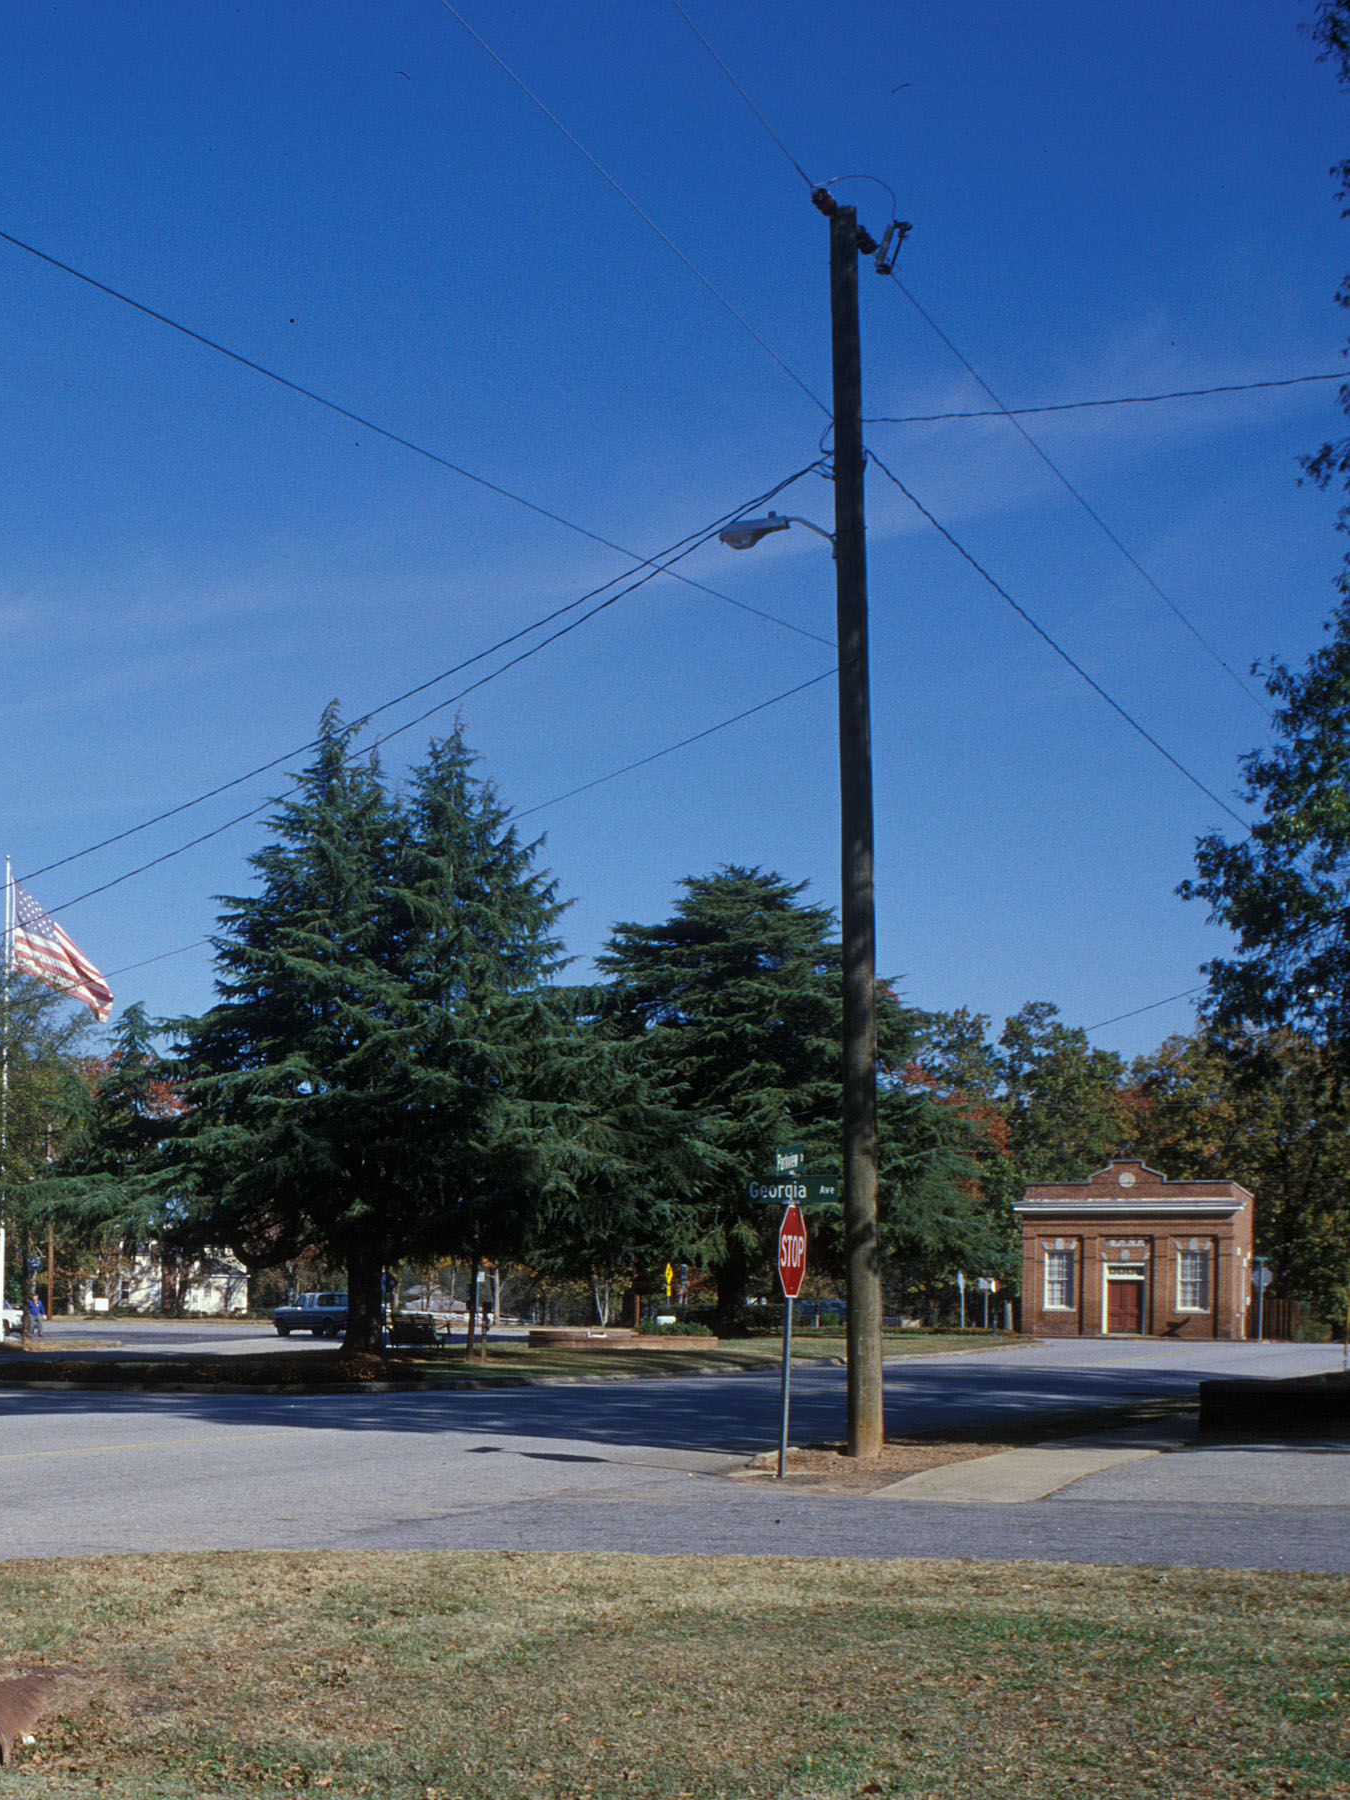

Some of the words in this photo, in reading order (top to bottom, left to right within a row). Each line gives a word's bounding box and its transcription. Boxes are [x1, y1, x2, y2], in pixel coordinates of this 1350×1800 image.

[749, 1181, 807, 1202] Georgia
[819, 1185, 835, 1195] Ave
[780, 1234, 804, 1267] STOP
